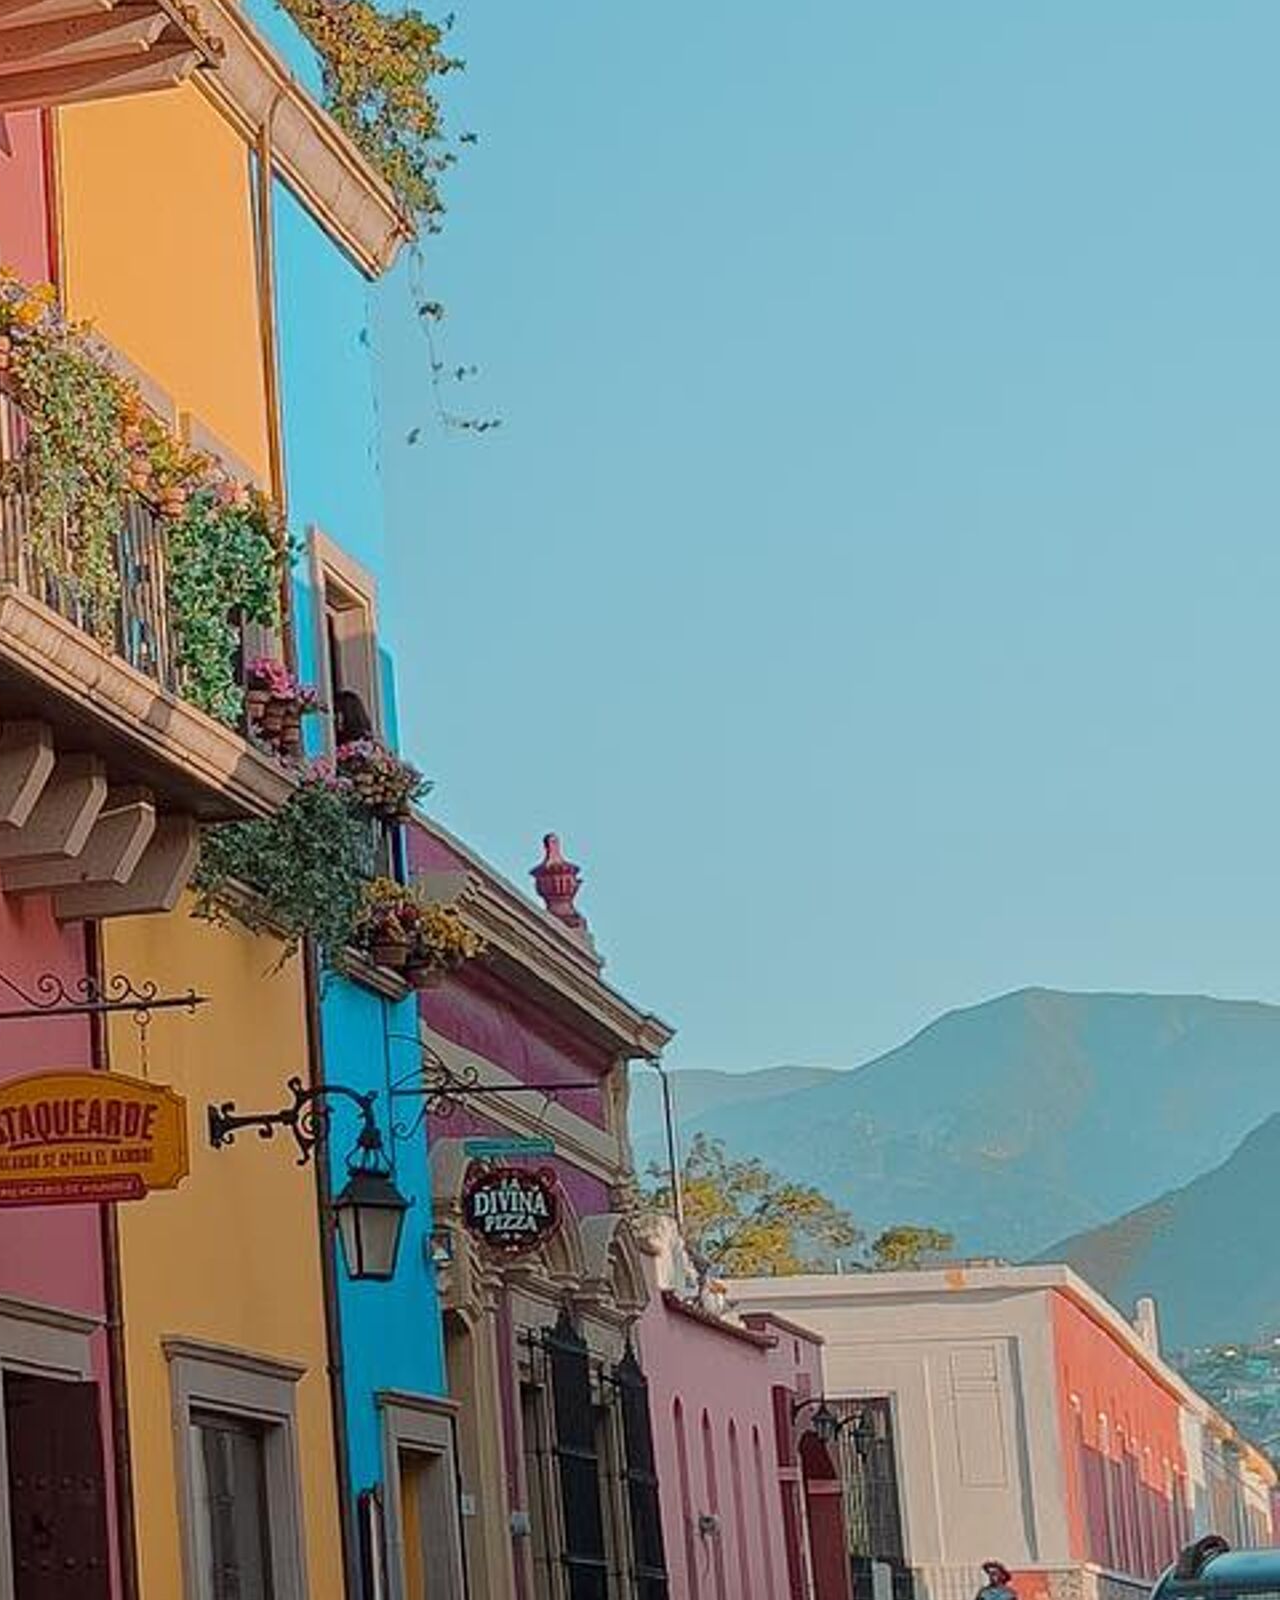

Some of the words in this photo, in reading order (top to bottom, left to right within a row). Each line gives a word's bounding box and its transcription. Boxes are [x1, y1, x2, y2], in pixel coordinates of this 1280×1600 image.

[500, 1178, 521, 1190] LA
[474, 1191, 549, 1217] DIVINA
[485, 1214, 537, 1232] PIZZA
